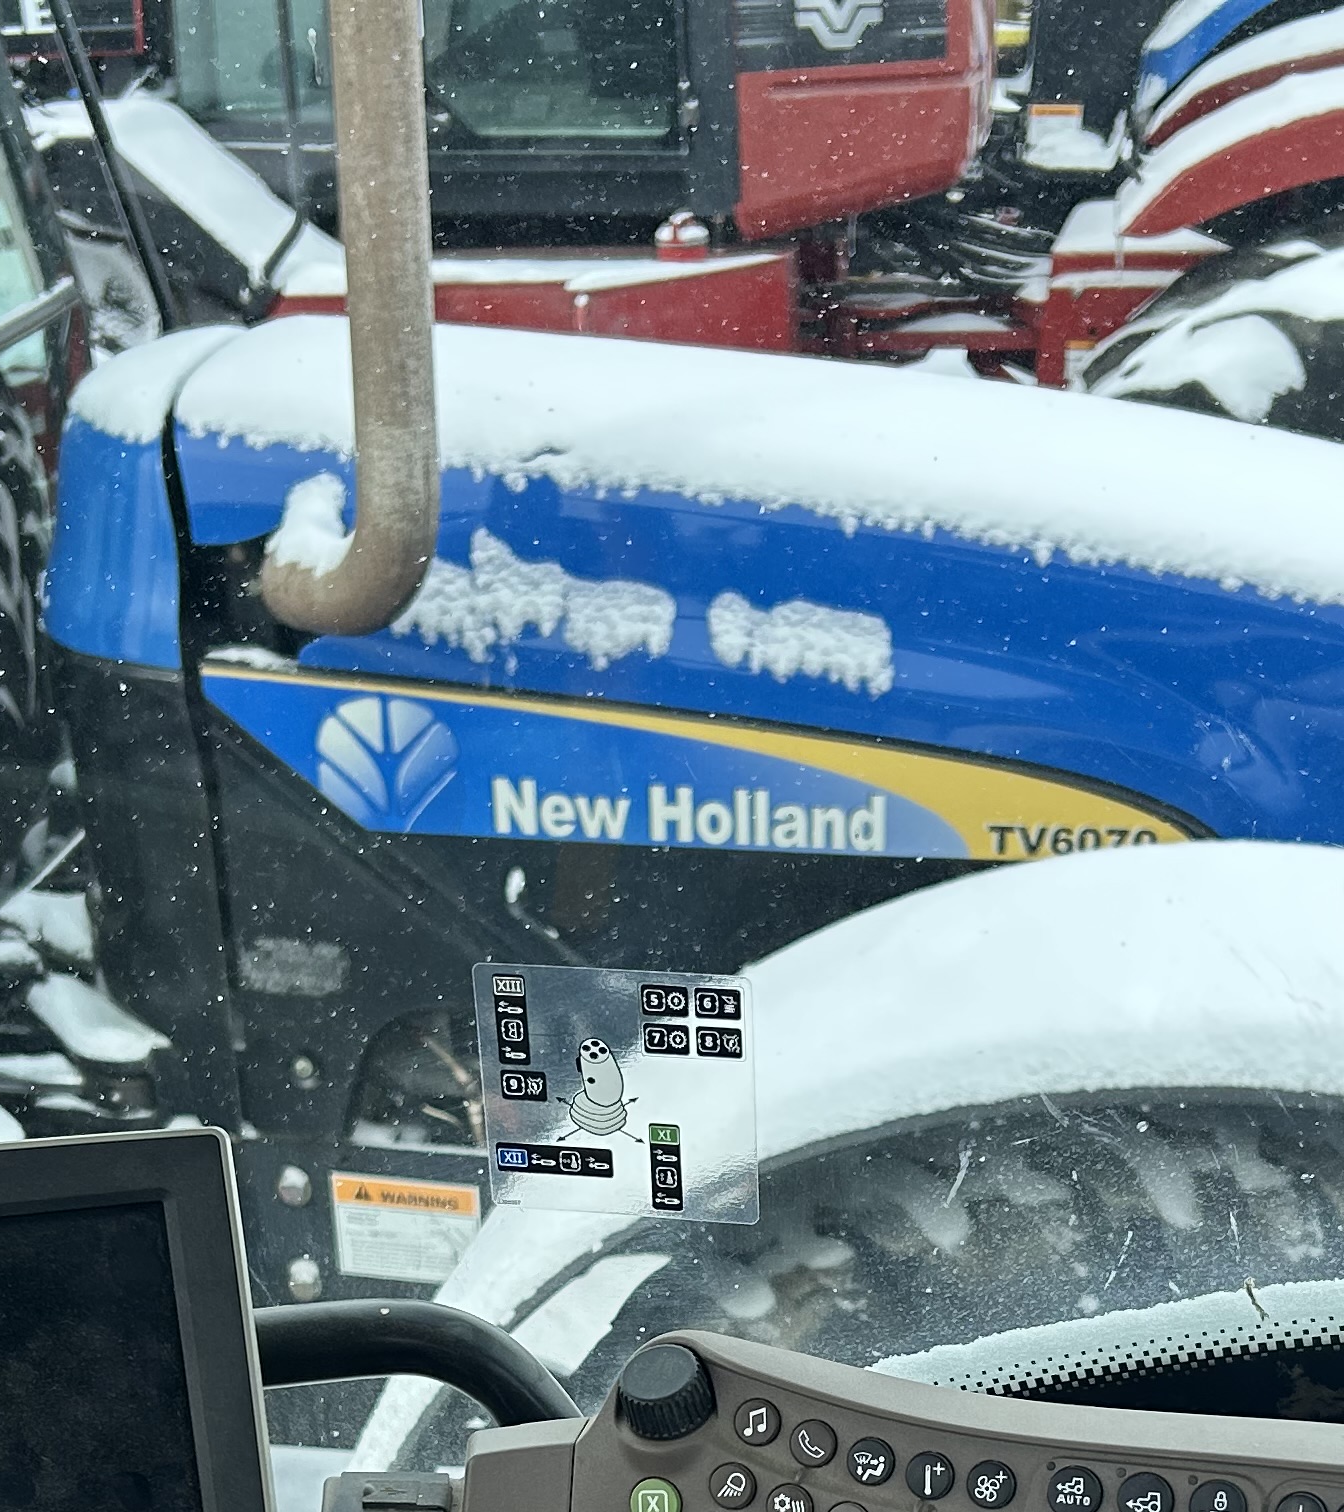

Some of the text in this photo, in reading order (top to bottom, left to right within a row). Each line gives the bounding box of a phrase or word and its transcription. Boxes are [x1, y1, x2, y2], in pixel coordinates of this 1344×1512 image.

[491, 777, 887, 853] New Holland
[497, 979, 521, 993] XIII
[650, 994, 658, 1006] 5
[702, 997, 711, 1009] 6
[652, 1033, 661, 1045] 7
[704, 1036, 713, 1048] 8
[509, 1079, 518, 1090] 9
[657, 1129, 672, 1141] XI
[503, 1152, 523, 1164] XII
[646, 1495, 660, 1512] X
[1056, 1494, 1091, 1506] AUTO
